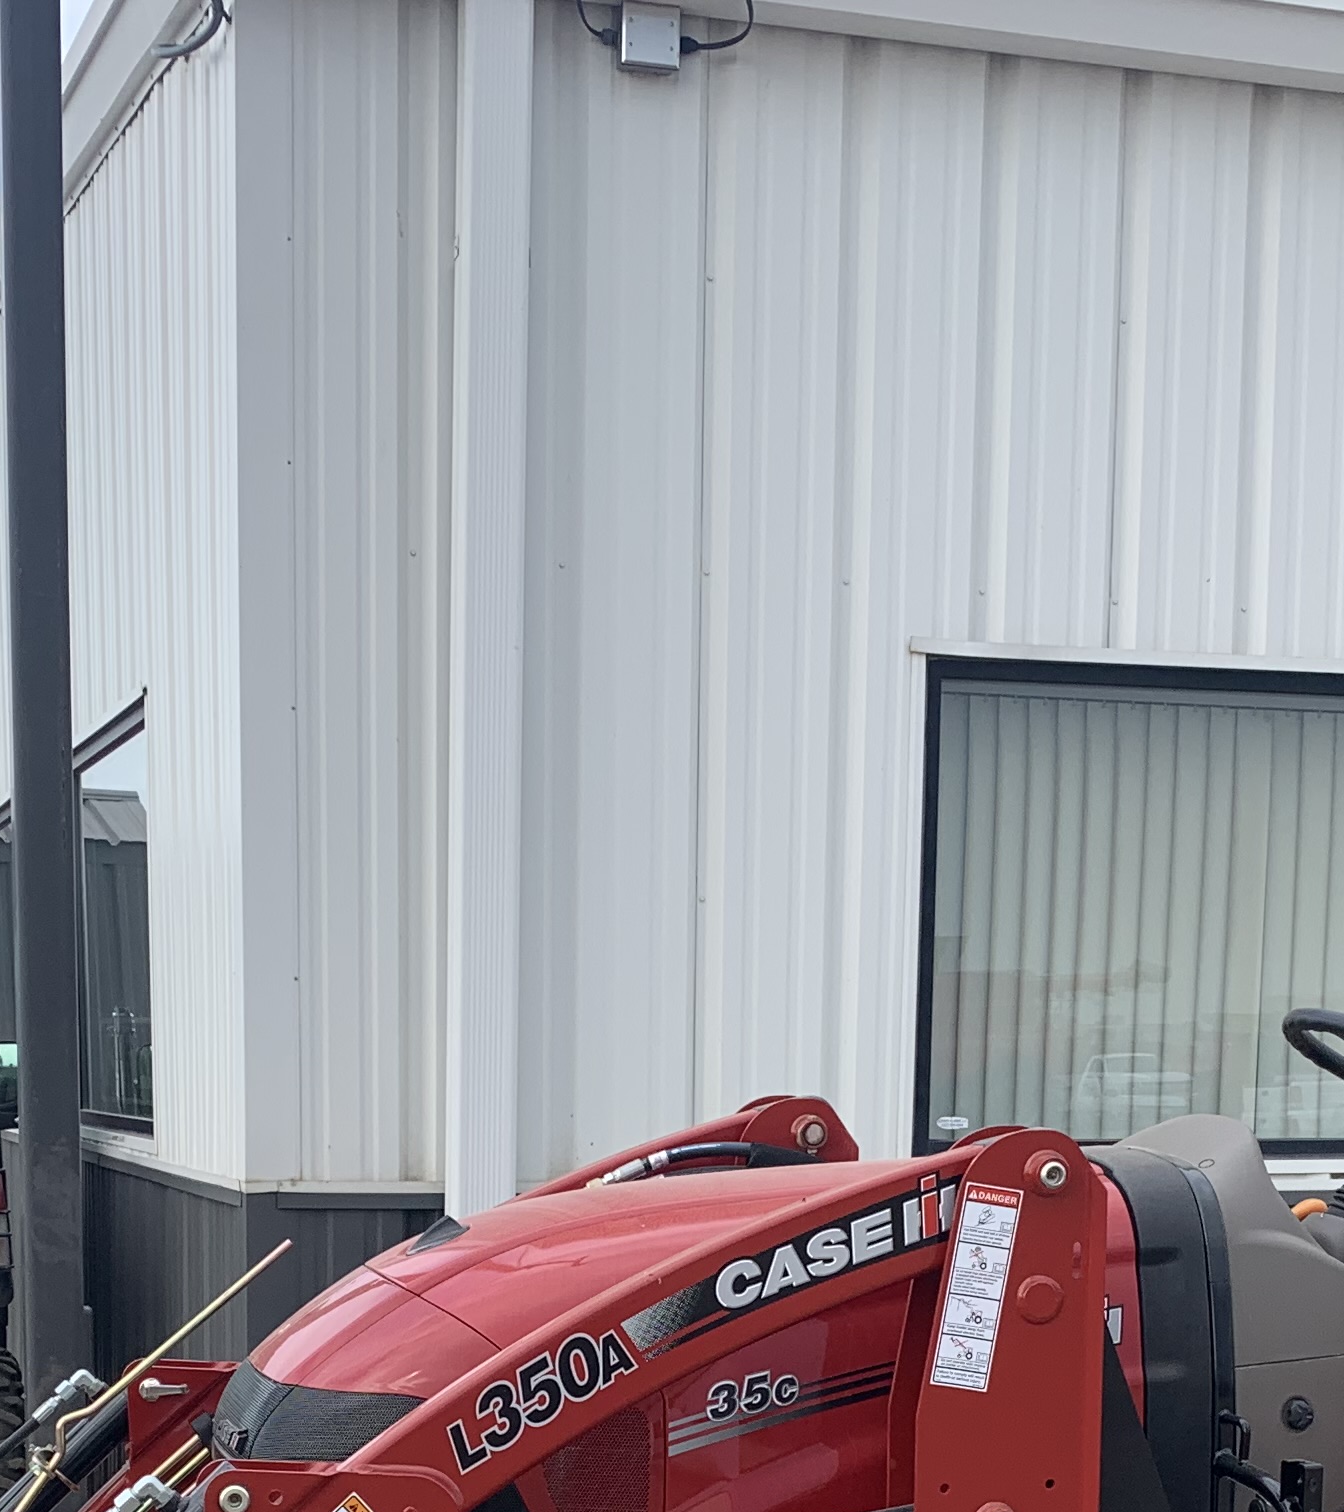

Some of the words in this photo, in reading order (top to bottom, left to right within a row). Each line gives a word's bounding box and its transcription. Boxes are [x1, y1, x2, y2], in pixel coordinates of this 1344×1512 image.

[977, 1191, 1017, 1206] DANGER
[715, 1207, 894, 1310] CASE
[446, 1328, 639, 1476] L350A
